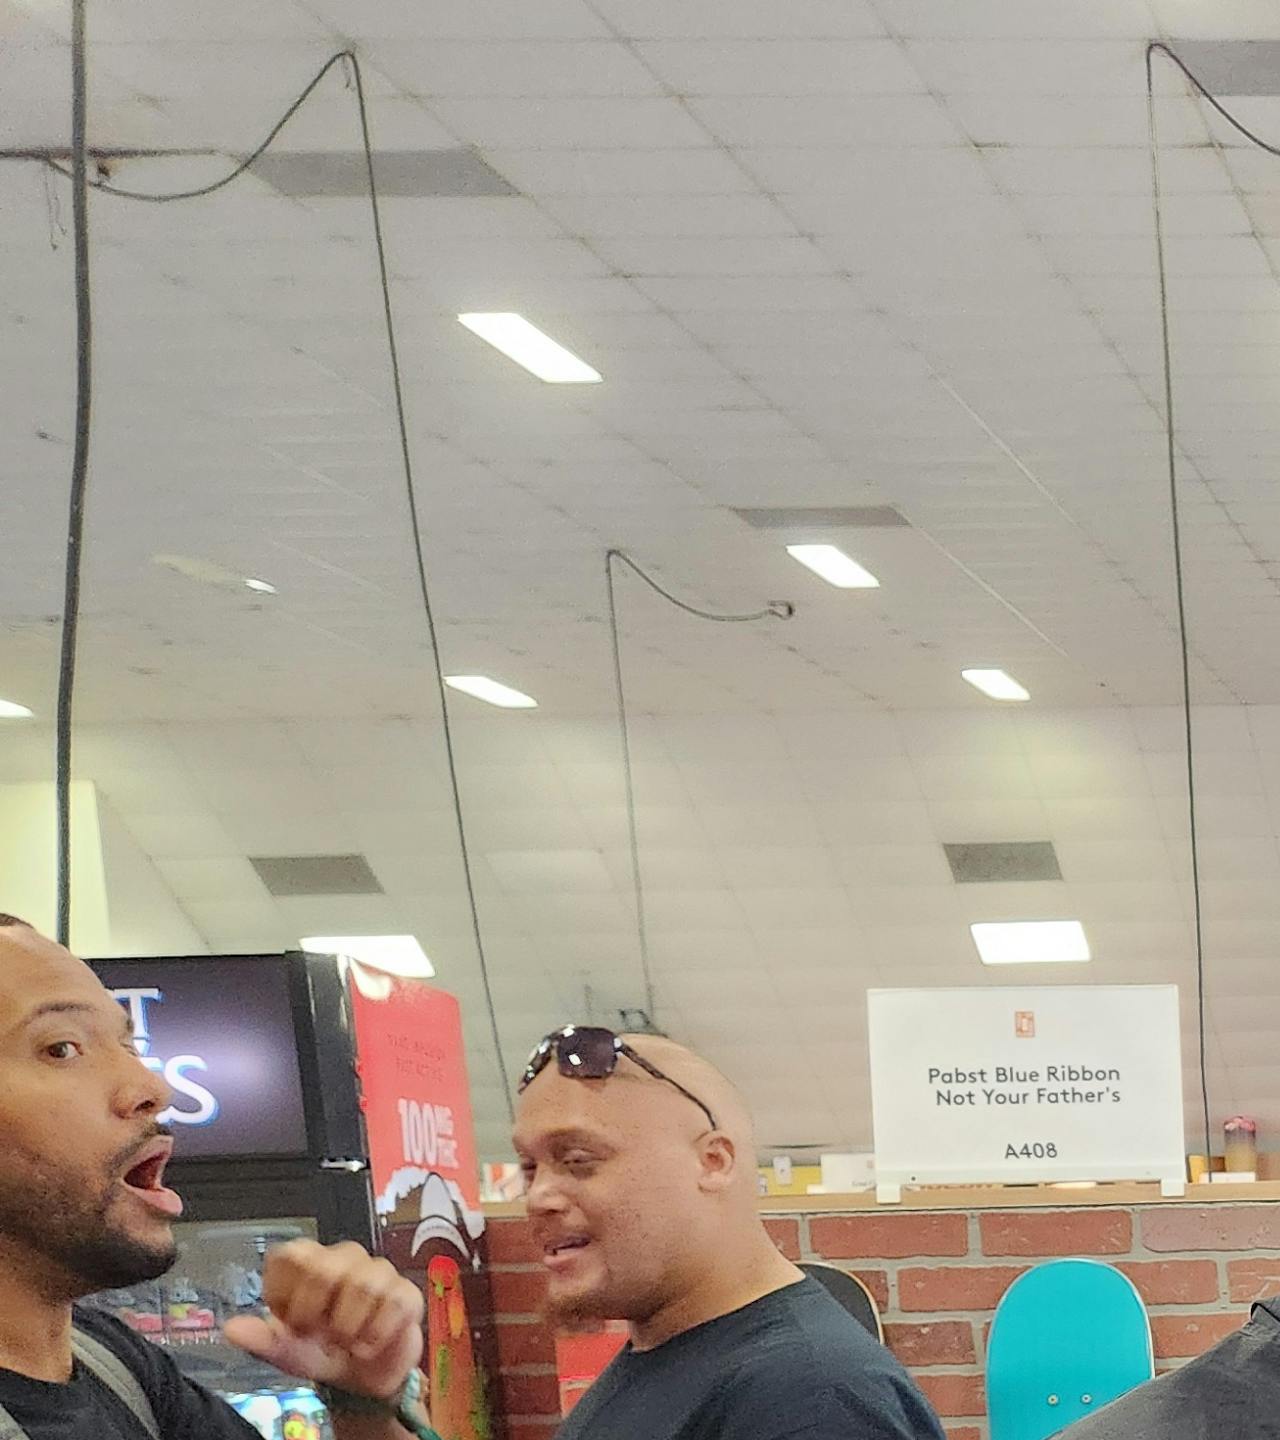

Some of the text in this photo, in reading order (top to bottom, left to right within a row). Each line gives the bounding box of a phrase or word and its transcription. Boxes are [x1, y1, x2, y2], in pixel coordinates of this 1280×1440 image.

[928, 1065, 1121, 1085] Pabst Blue Ribbon
[936, 1086, 1121, 1106] Not Your Father's
[1004, 1142, 1058, 1159] A408
